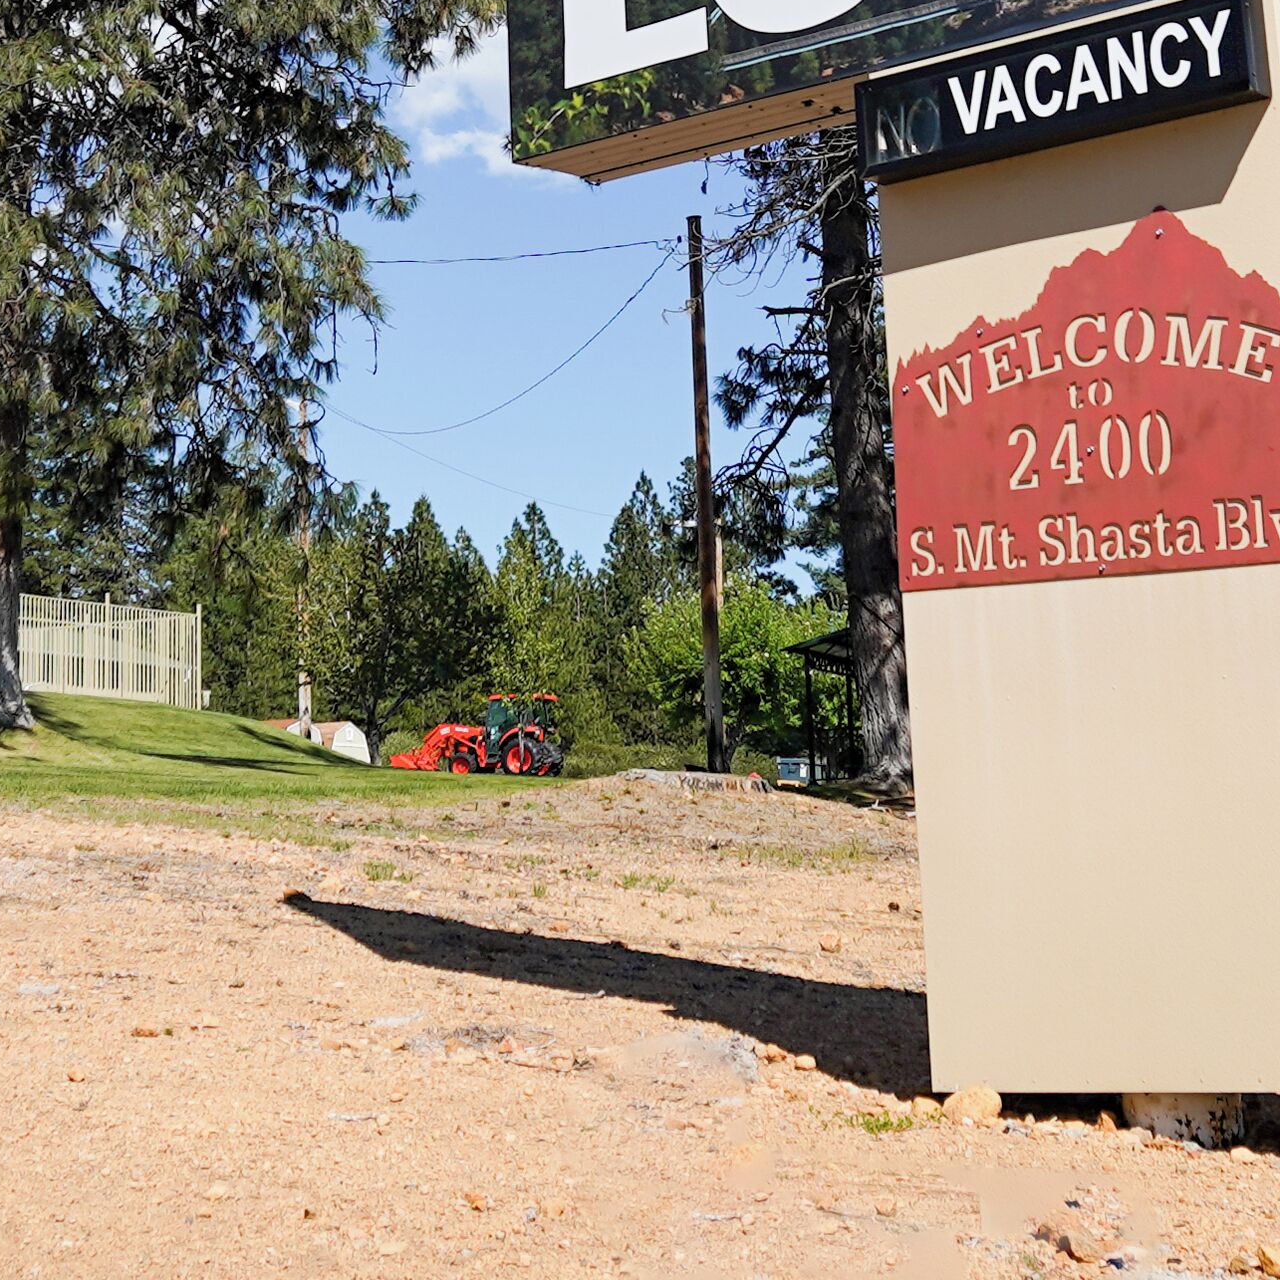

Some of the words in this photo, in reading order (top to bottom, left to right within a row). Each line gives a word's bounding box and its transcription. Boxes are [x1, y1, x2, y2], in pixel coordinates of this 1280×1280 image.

[875, 97, 941, 162] NO
[948, 9, 1231, 135] VACANCY
[916, 307, 1280, 418] WELCOME
[1068, 377, 1114, 410] to
[1007, 409, 1173, 491] 2400
[910, 526, 944, 577] S.
[954, 523, 1027, 573] Mt.
[1038, 514, 1204, 567] Shasta
